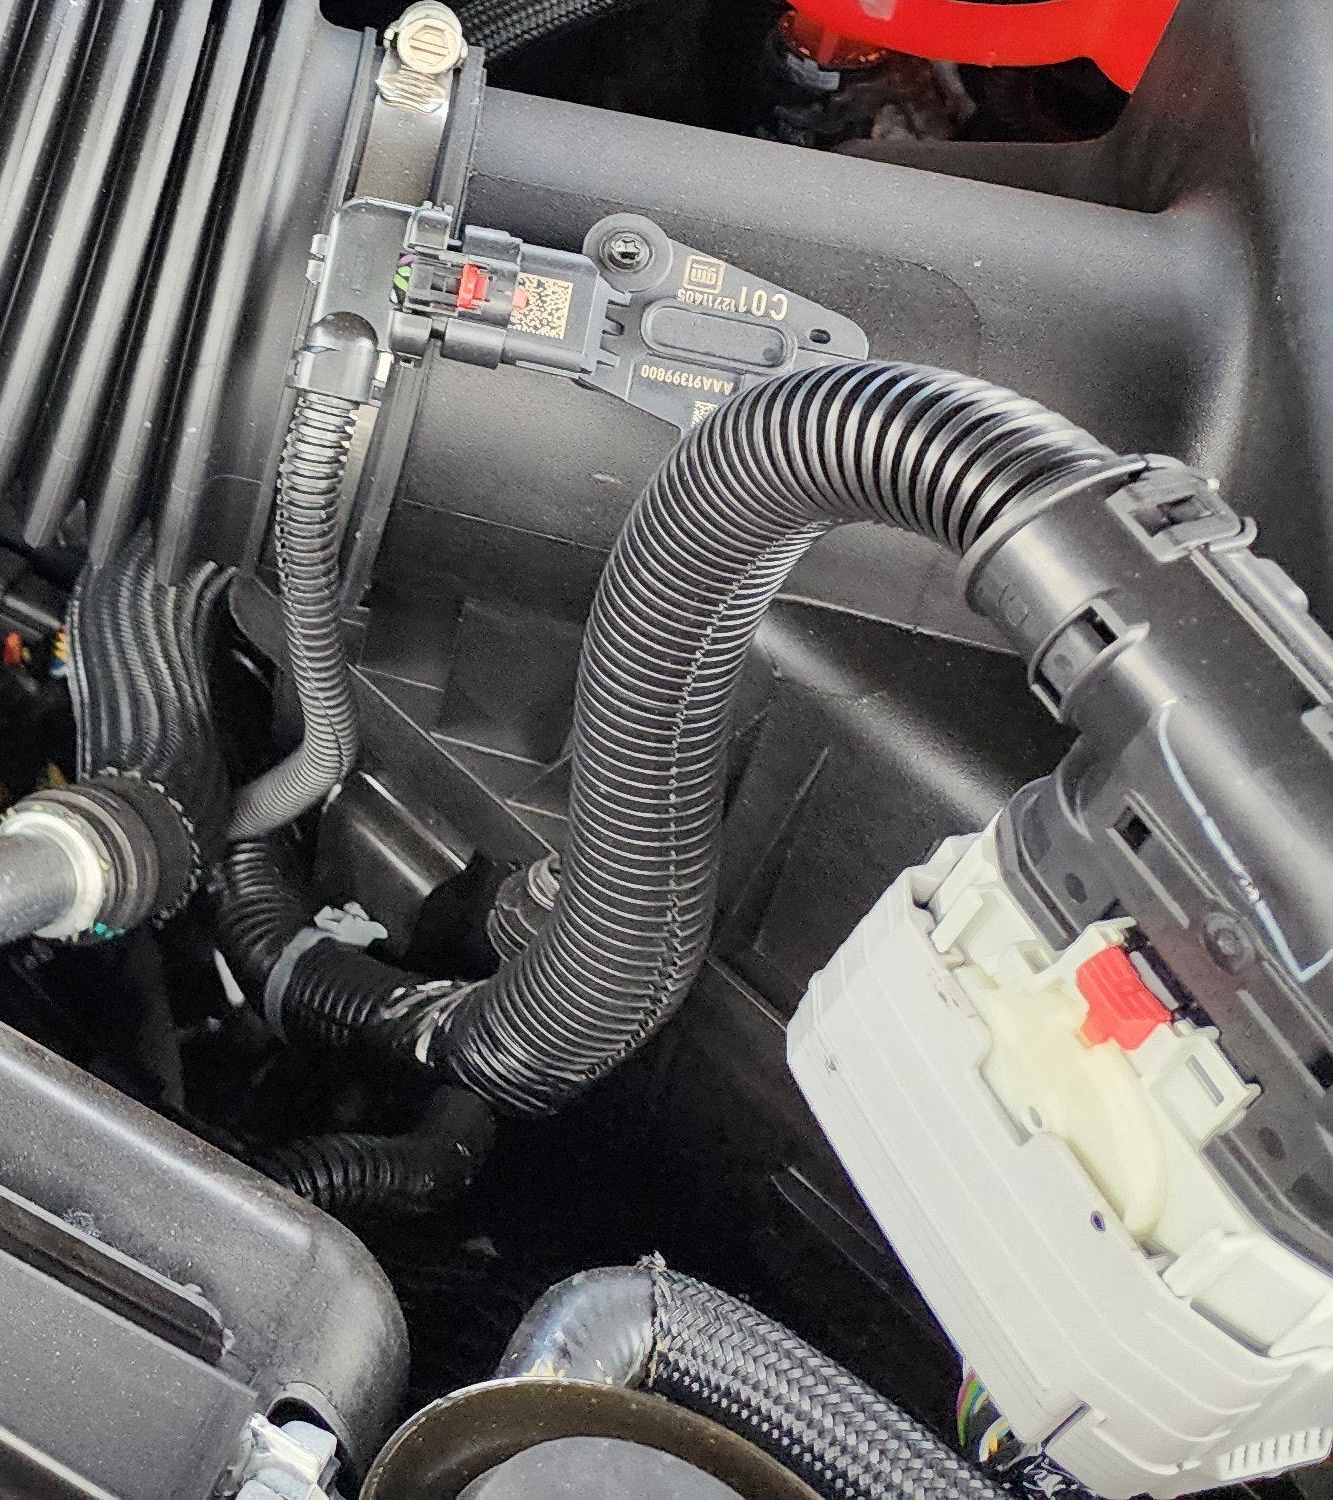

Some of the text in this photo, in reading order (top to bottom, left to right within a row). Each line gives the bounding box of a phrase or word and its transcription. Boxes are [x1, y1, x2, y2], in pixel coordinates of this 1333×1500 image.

[676, 288, 737, 313] 12711405
[738, 286, 788, 321] C01
[640, 364, 735, 396] AAA91399800
